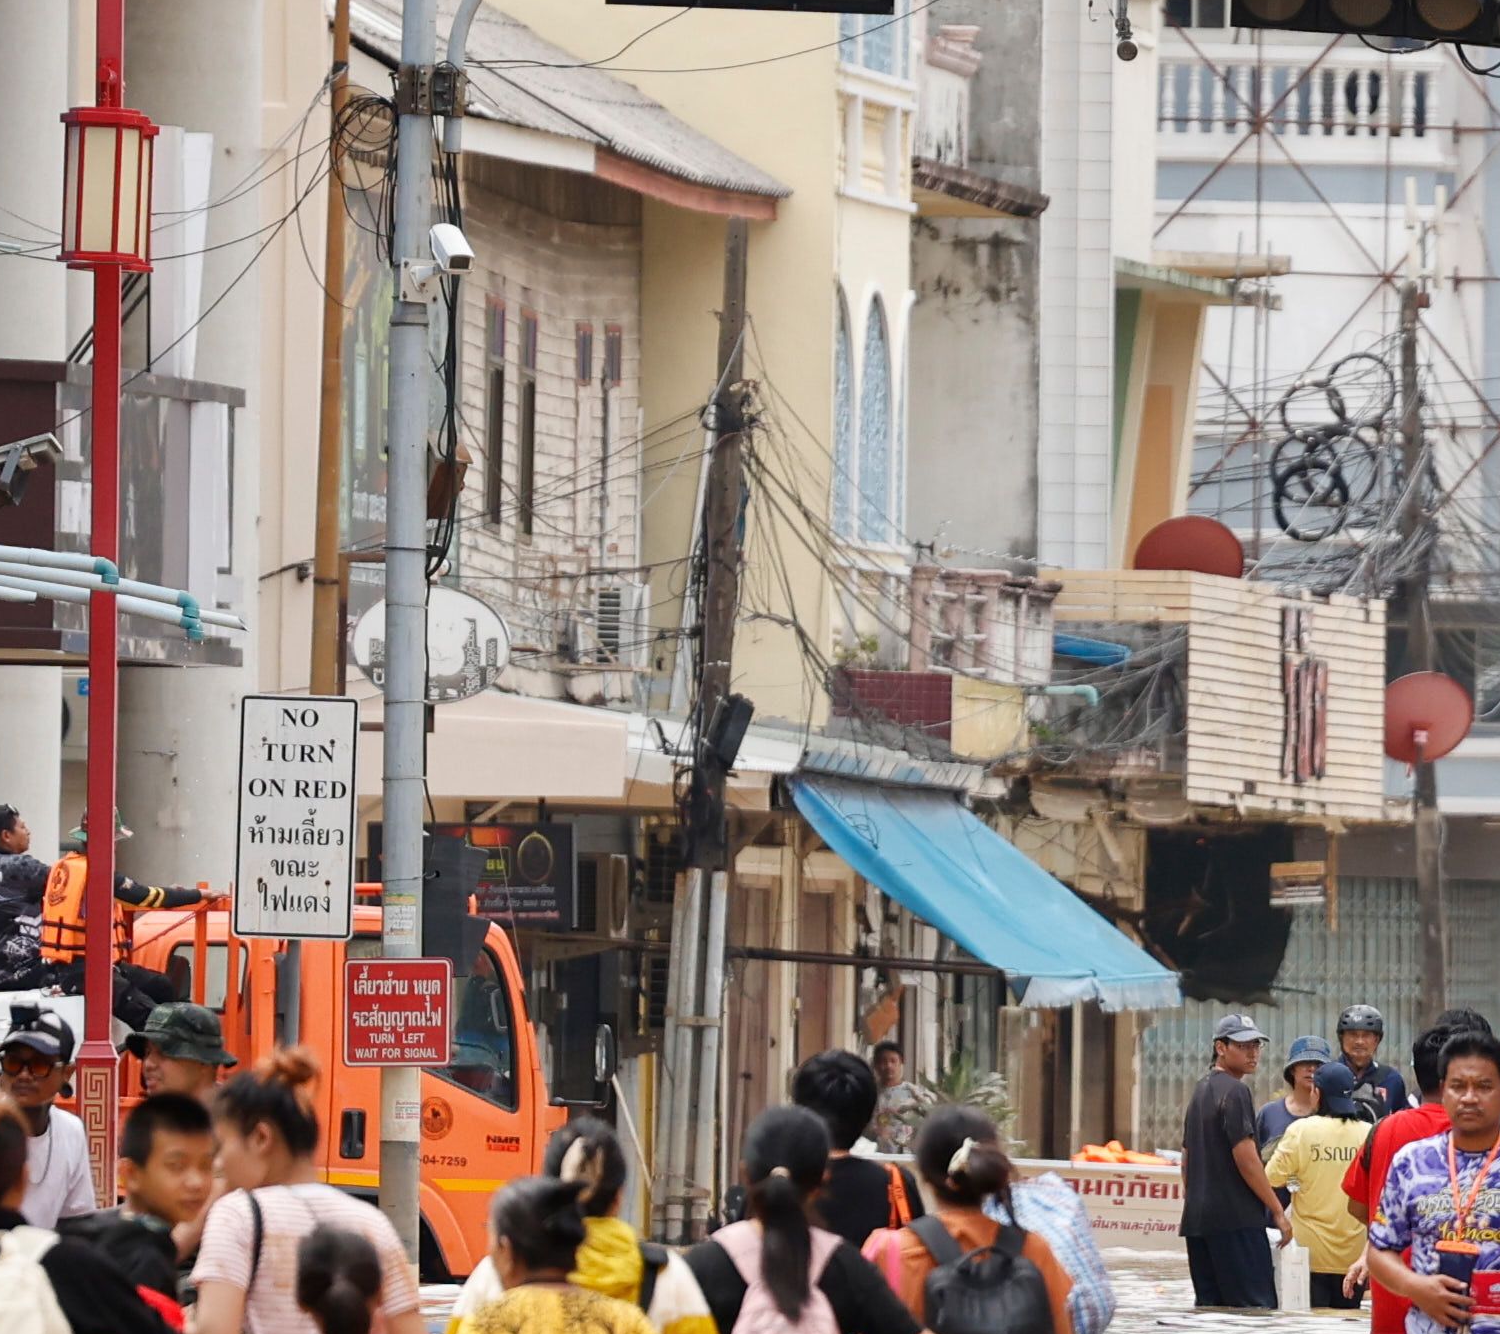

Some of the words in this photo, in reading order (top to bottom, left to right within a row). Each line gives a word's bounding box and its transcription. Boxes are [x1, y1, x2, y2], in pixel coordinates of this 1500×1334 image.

[281, 708, 319, 728] NO
[262, 742, 334, 764] TURN
[248, 778, 287, 798] ON
[294, 779, 347, 799] RED
[248, 807, 344, 846] ห้ามเลี้ยว
[270, 857, 320, 878] ขณะ
[258, 880, 332, 914] ไฟแดง
[354, 966, 408, 996] เลี้ยวซ้าย
[413, 978, 441, 1001] หยุด
[369, 1033, 395, 1044] TURN
[402, 1033, 425, 1044] LEFT
[355, 1048, 378, 1058] WAIT
[382, 1048, 401, 1058] FOR
[404, 1048, 438, 1058] SIGNAL
